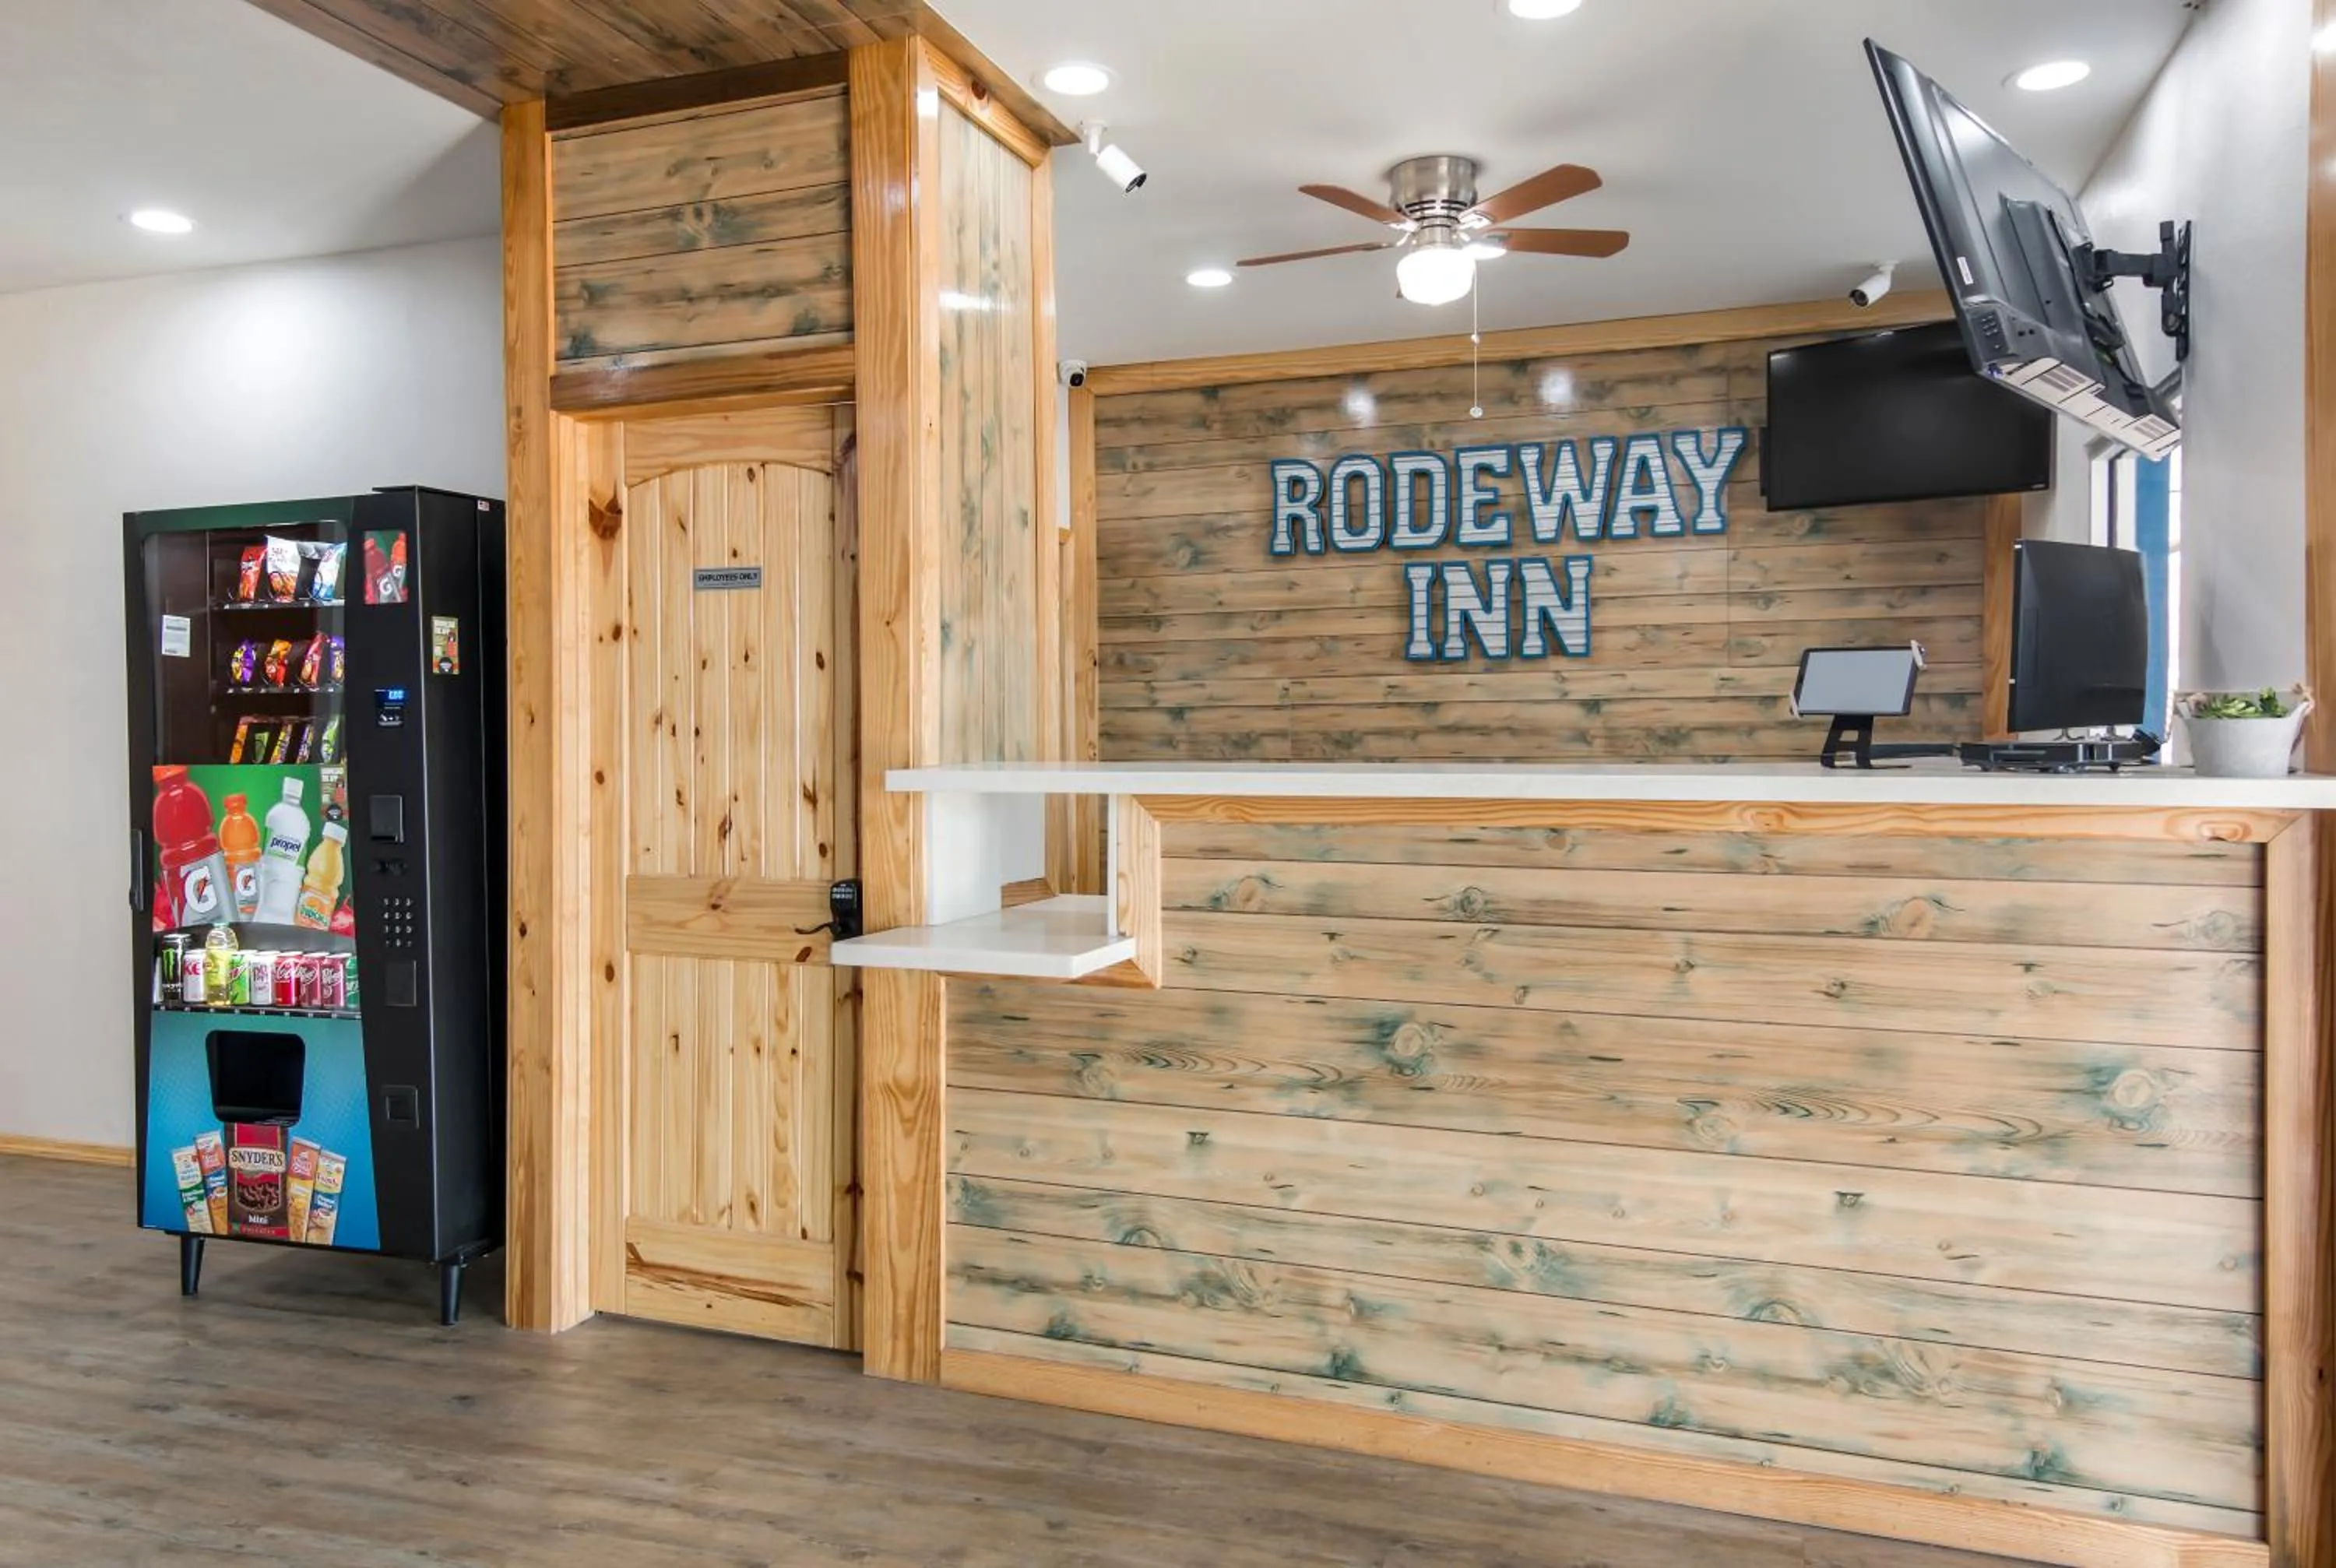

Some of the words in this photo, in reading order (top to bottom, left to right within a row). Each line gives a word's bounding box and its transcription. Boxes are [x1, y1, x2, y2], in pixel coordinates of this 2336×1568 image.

[1270, 426, 1749, 556] RODEWAY
[698, 572, 738, 582] EMPLOYEES
[739, 571, 758, 581] ONLY
[1405, 554, 1594, 661] INN
[270, 837, 301, 853] propel
[184, 866, 217, 913] G
[236, 868, 257, 897] G
[231, 1149, 283, 1167] SNYDER'S
